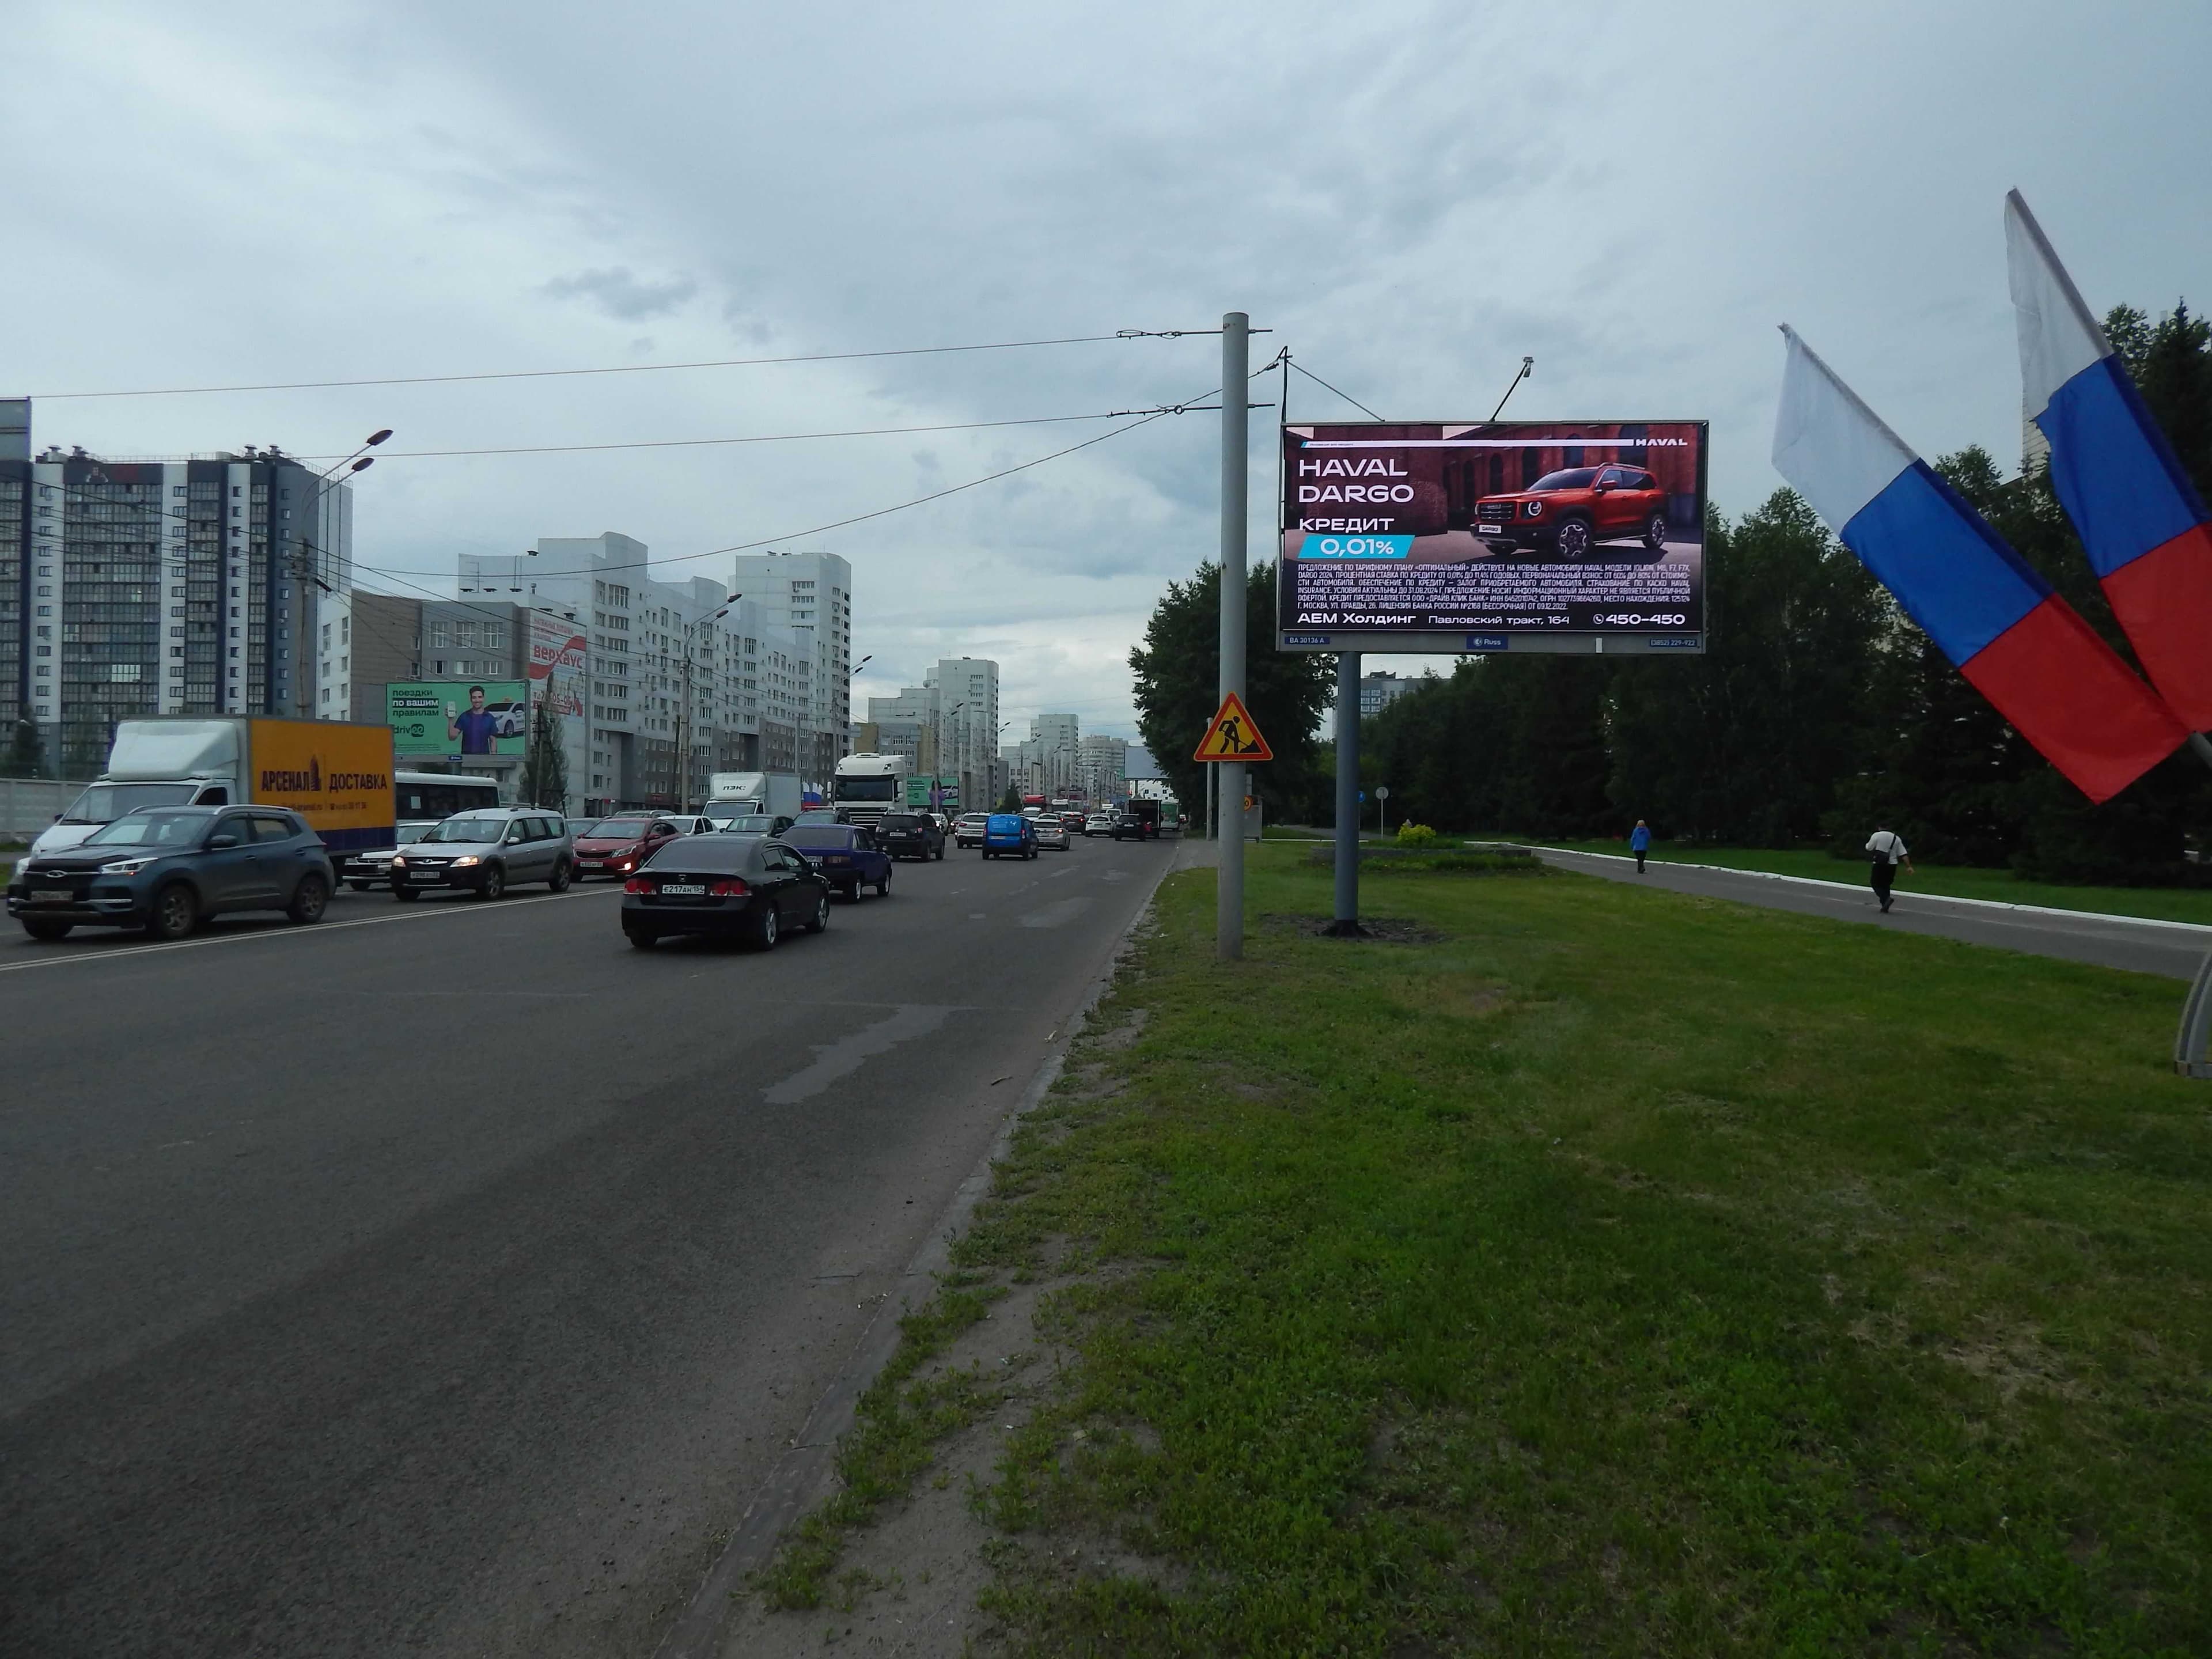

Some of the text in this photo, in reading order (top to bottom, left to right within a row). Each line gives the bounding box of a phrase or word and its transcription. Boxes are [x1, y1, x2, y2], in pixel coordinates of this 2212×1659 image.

[1299, 459, 1408, 476] HAVAL
[1299, 484, 1414, 503] DARGO
[1299, 518, 1395, 533] КРЕДИТ
[1320, 539, 1395, 557] 0,01%
[1297, 613, 1337, 623] АЕМ
[1342, 613, 1416, 624] Холдинг
[1429, 615, 1502, 624] Павловский
[1507, 617, 1544, 626] тракт,
[1605, 614, 1685, 625] 450-450
[392, 689, 433, 697] поездки
[262, 771, 388, 793] АРСЕНАЛ ДОСТАВКА
